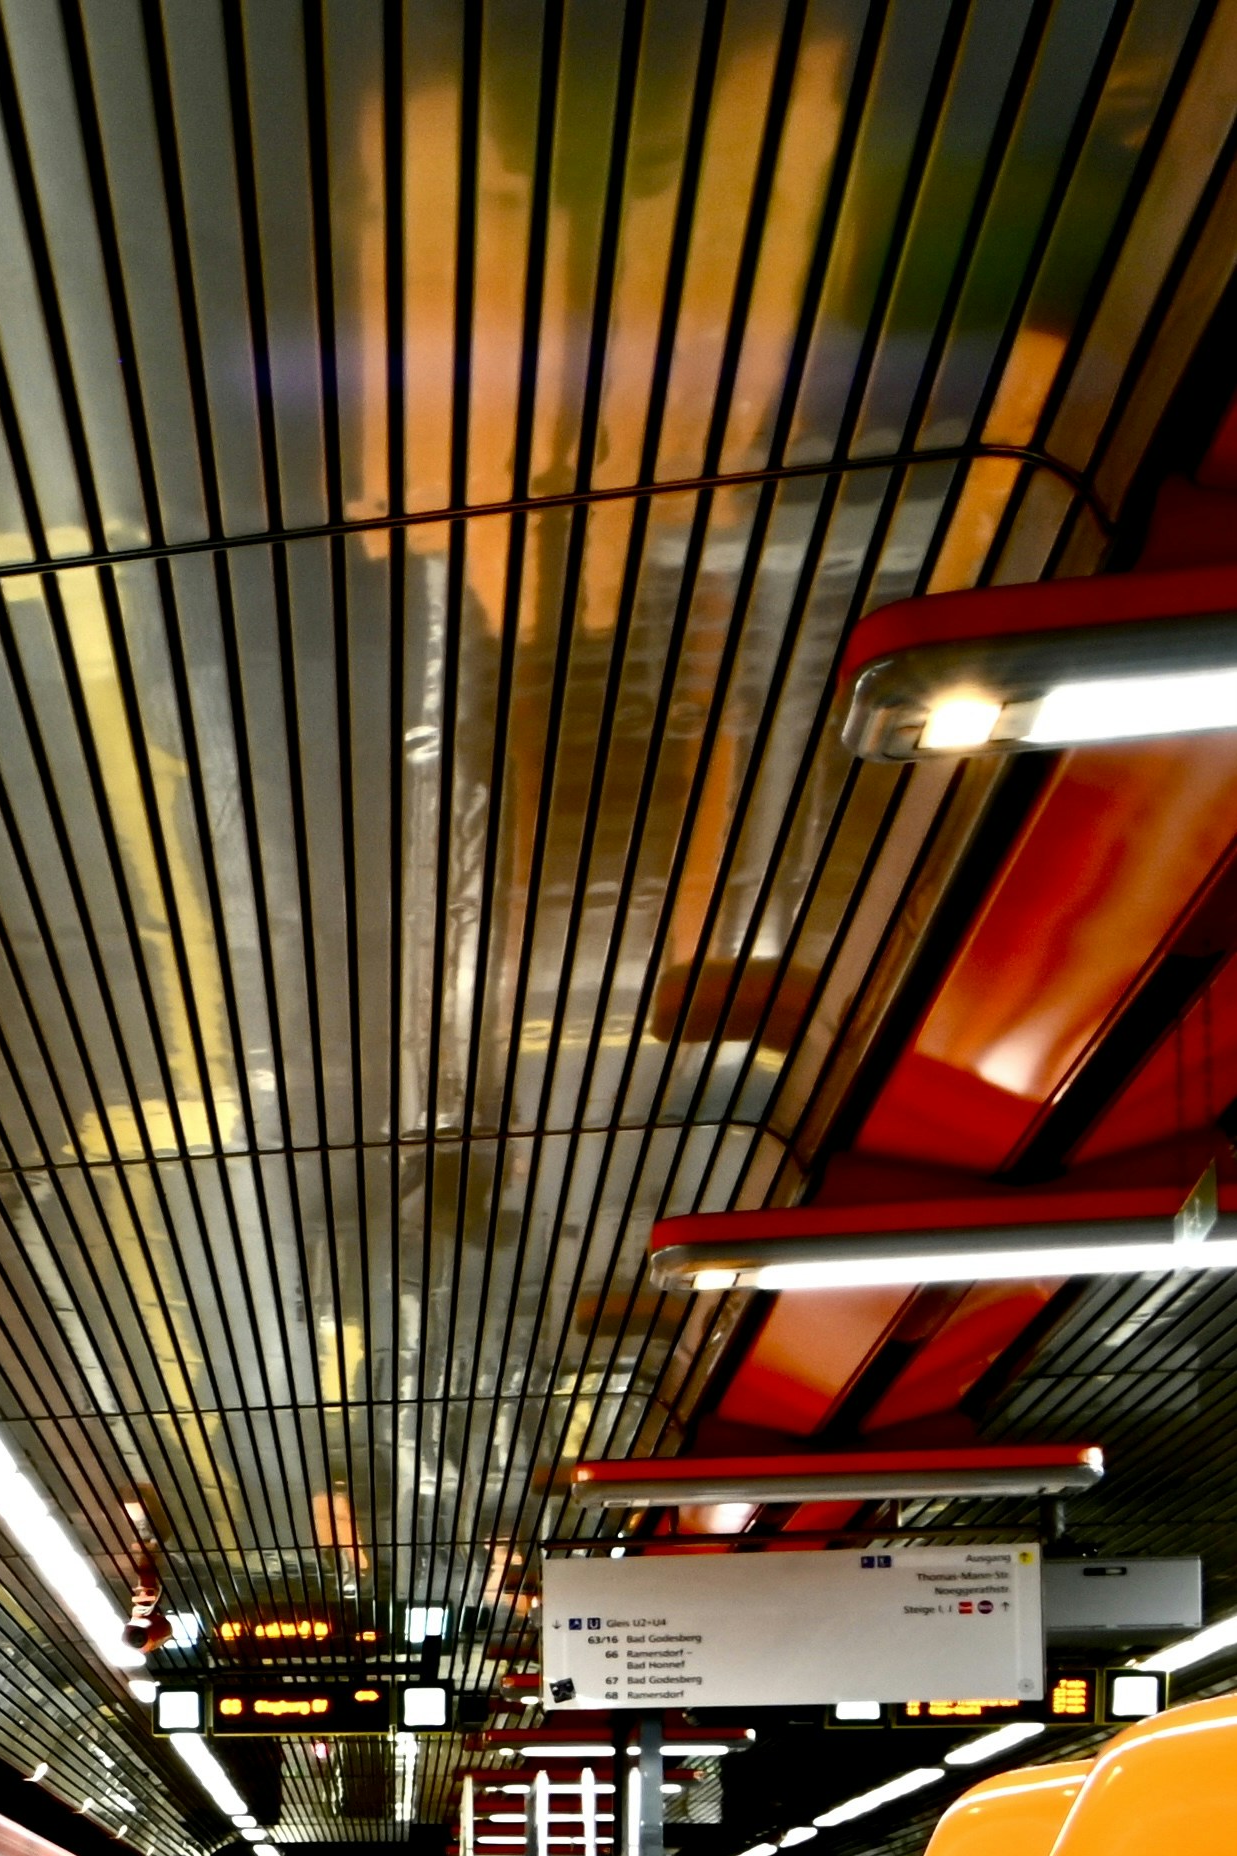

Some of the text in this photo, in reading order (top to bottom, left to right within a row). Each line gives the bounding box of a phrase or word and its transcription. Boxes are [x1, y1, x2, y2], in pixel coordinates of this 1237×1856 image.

[966, 1554, 1012, 1564] Ausgang
[588, 1634, 702, 1644] 63/16 Bad Godesberg
[605, 1650, 619, 1658] 66
[627, 1649, 684, 1657] Ramersdorf
[627, 1660, 685, 1669] Bad Honnef
[605, 1676, 703, 1685] 67 Bad Godesberg
[605, 1690, 685, 1699] 68 Ramersdorf
